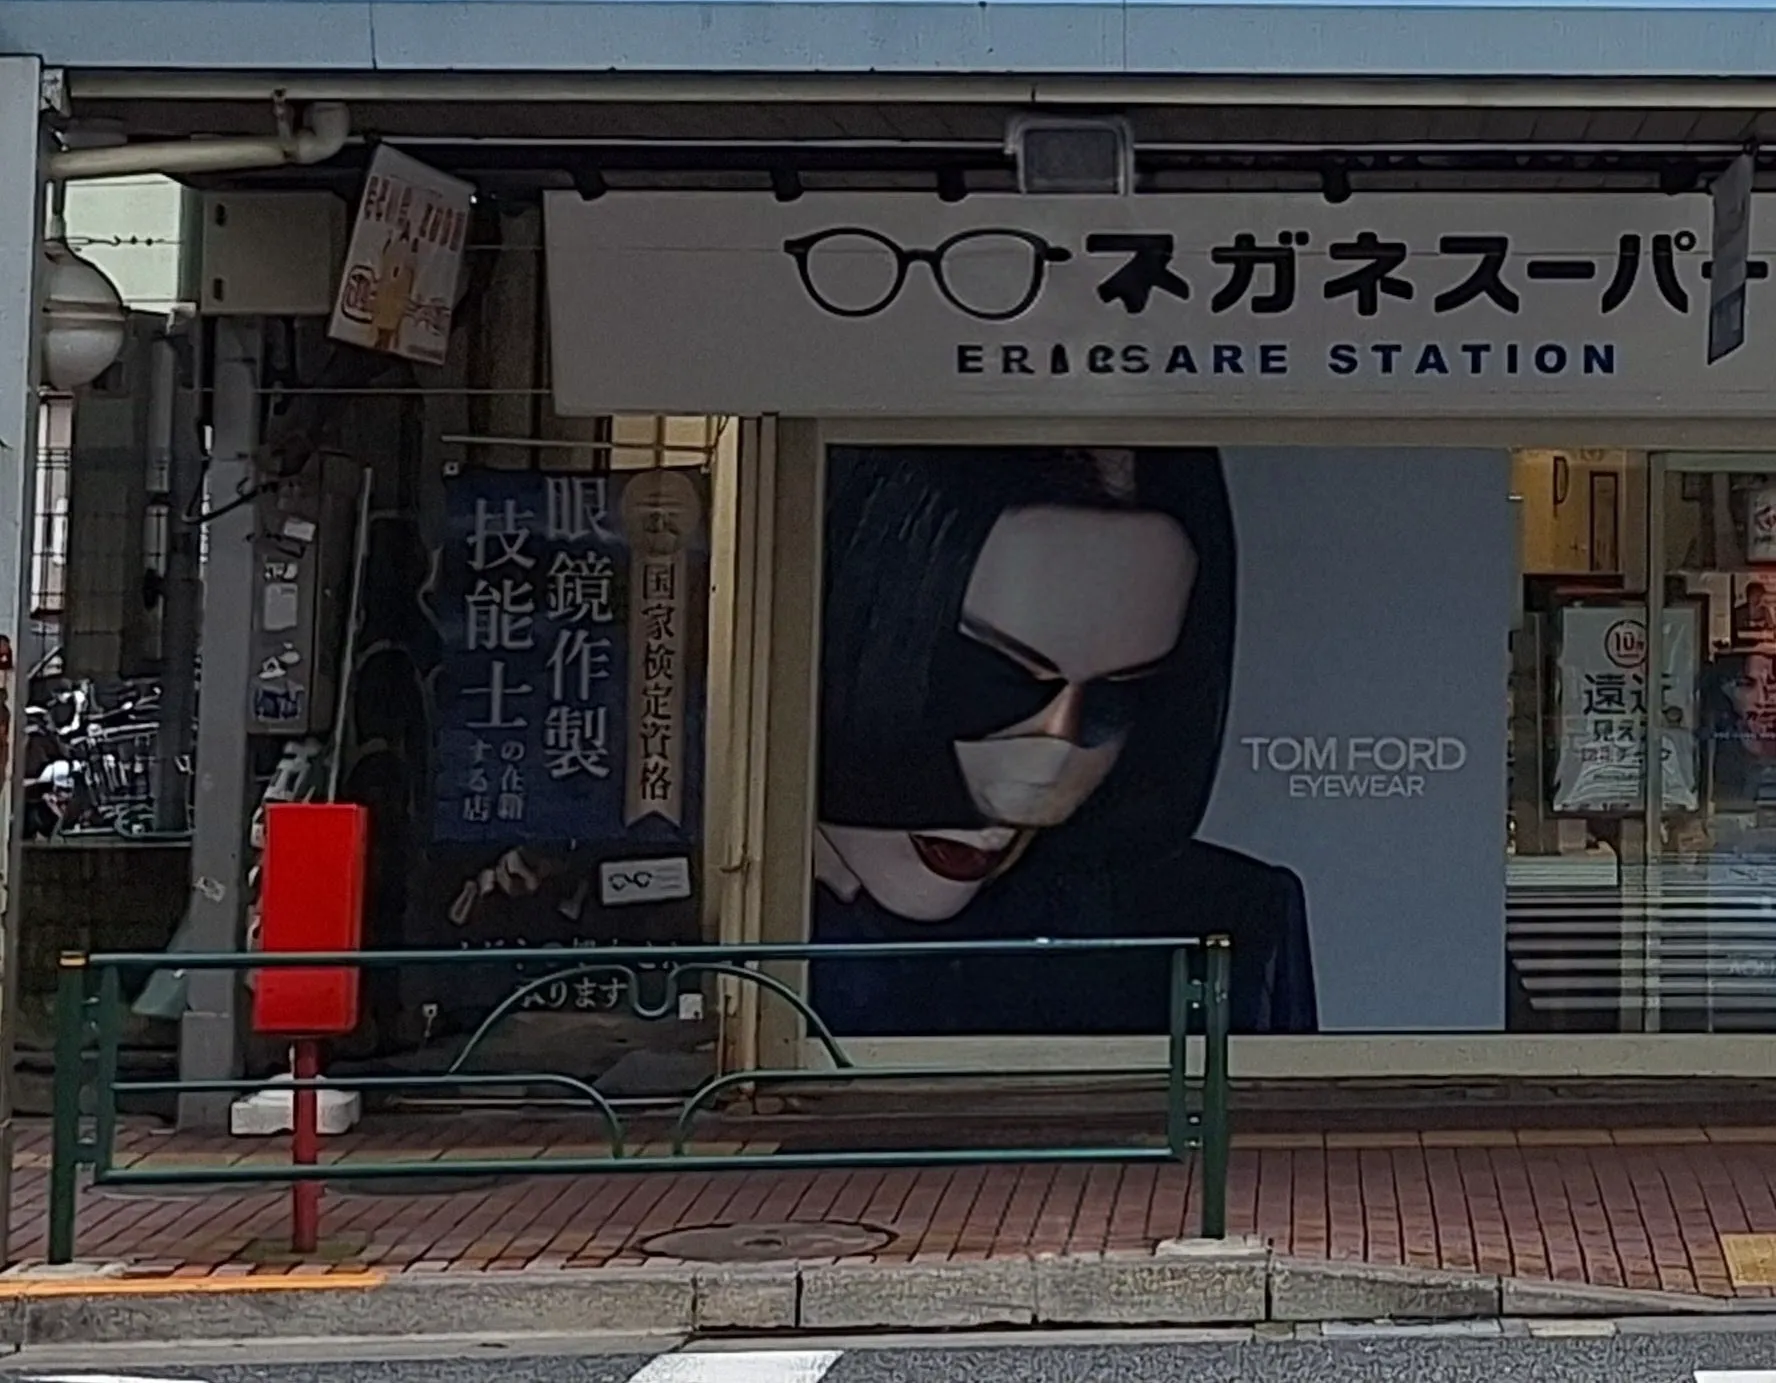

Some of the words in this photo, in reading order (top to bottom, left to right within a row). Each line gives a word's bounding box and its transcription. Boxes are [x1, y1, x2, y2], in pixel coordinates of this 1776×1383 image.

[1328, 343, 1616, 376] STATION
[461, 497, 538, 729] 技能士
[545, 476, 614, 780] 眼鏡作製
[1241, 736, 1338, 771] TOM
[1348, 736, 1467, 771] FORD
[1289, 773, 1425, 798] EYEWEAR
